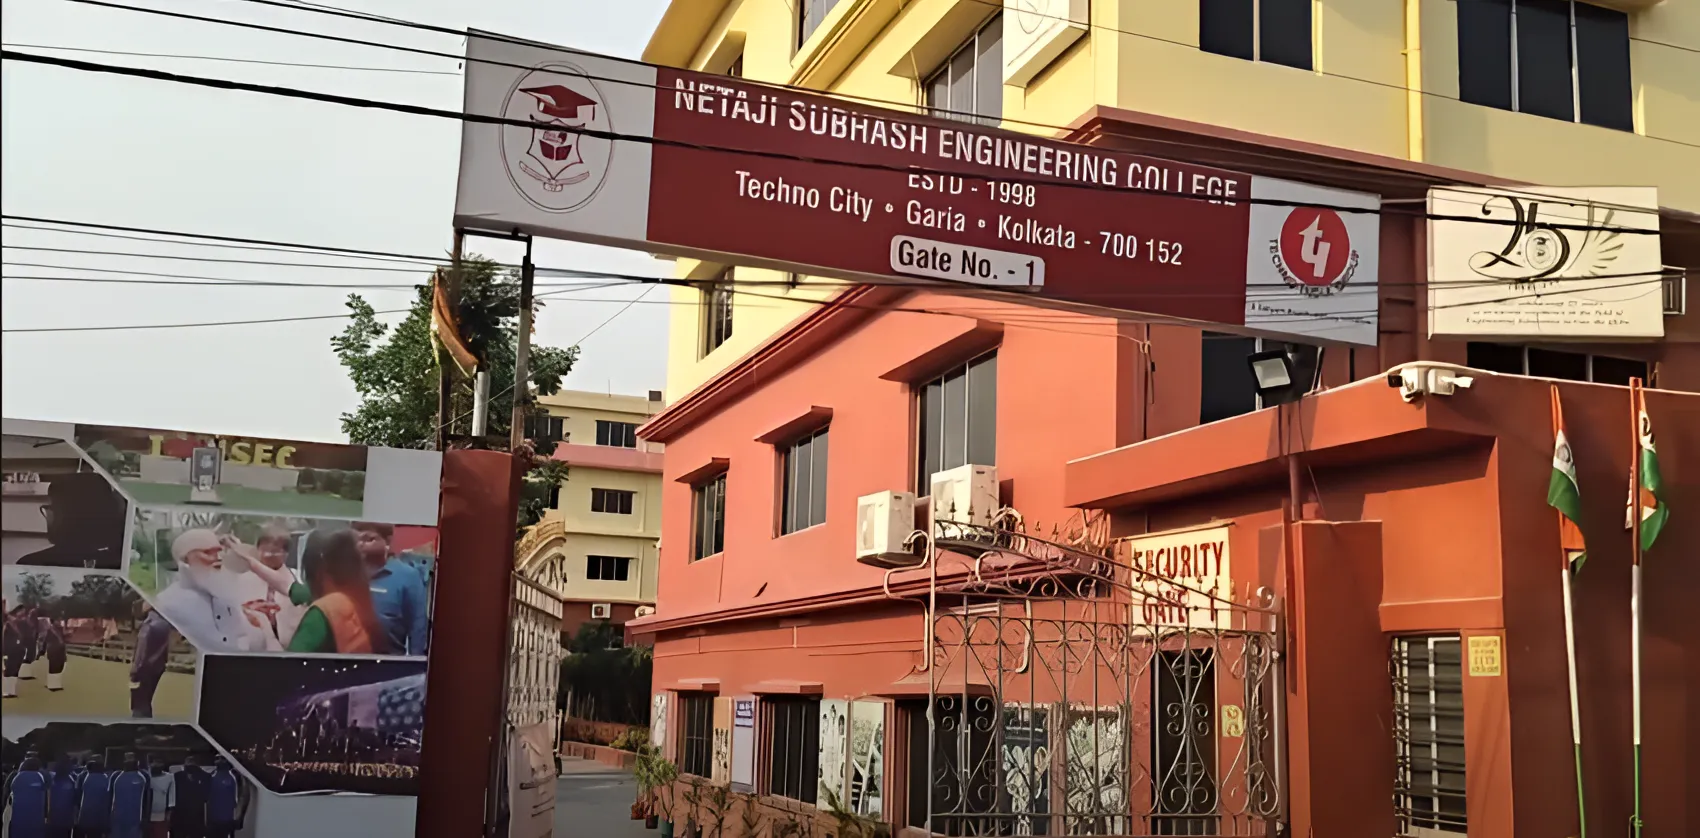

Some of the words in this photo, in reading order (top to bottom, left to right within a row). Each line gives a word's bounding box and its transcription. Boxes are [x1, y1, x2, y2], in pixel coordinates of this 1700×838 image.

[675, 78, 777, 126] NETAJI
[788, 100, 927, 154] SUBHASH
[939, 128, 1117, 187] ENGINEERING
[1127, 162, 1238, 207] COLLEGE
[908, 165, 963, 195] ESTD
[986, 181, 1036, 208] 1998
[735, 170, 820, 209] Techno
[829, 186, 873, 223] City
[906, 199, 966, 233] Garia
[998, 214, 1076, 249] Kolkata
[1099, 231, 1138, 259] 700
[1145, 238, 1183, 266] 152
[898, 239, 952, 273] Gate
[961, 249, 998, 280] No.
[1026, 260, 1035, 286] 1
[1133, 541, 1224, 582] SECURITY
